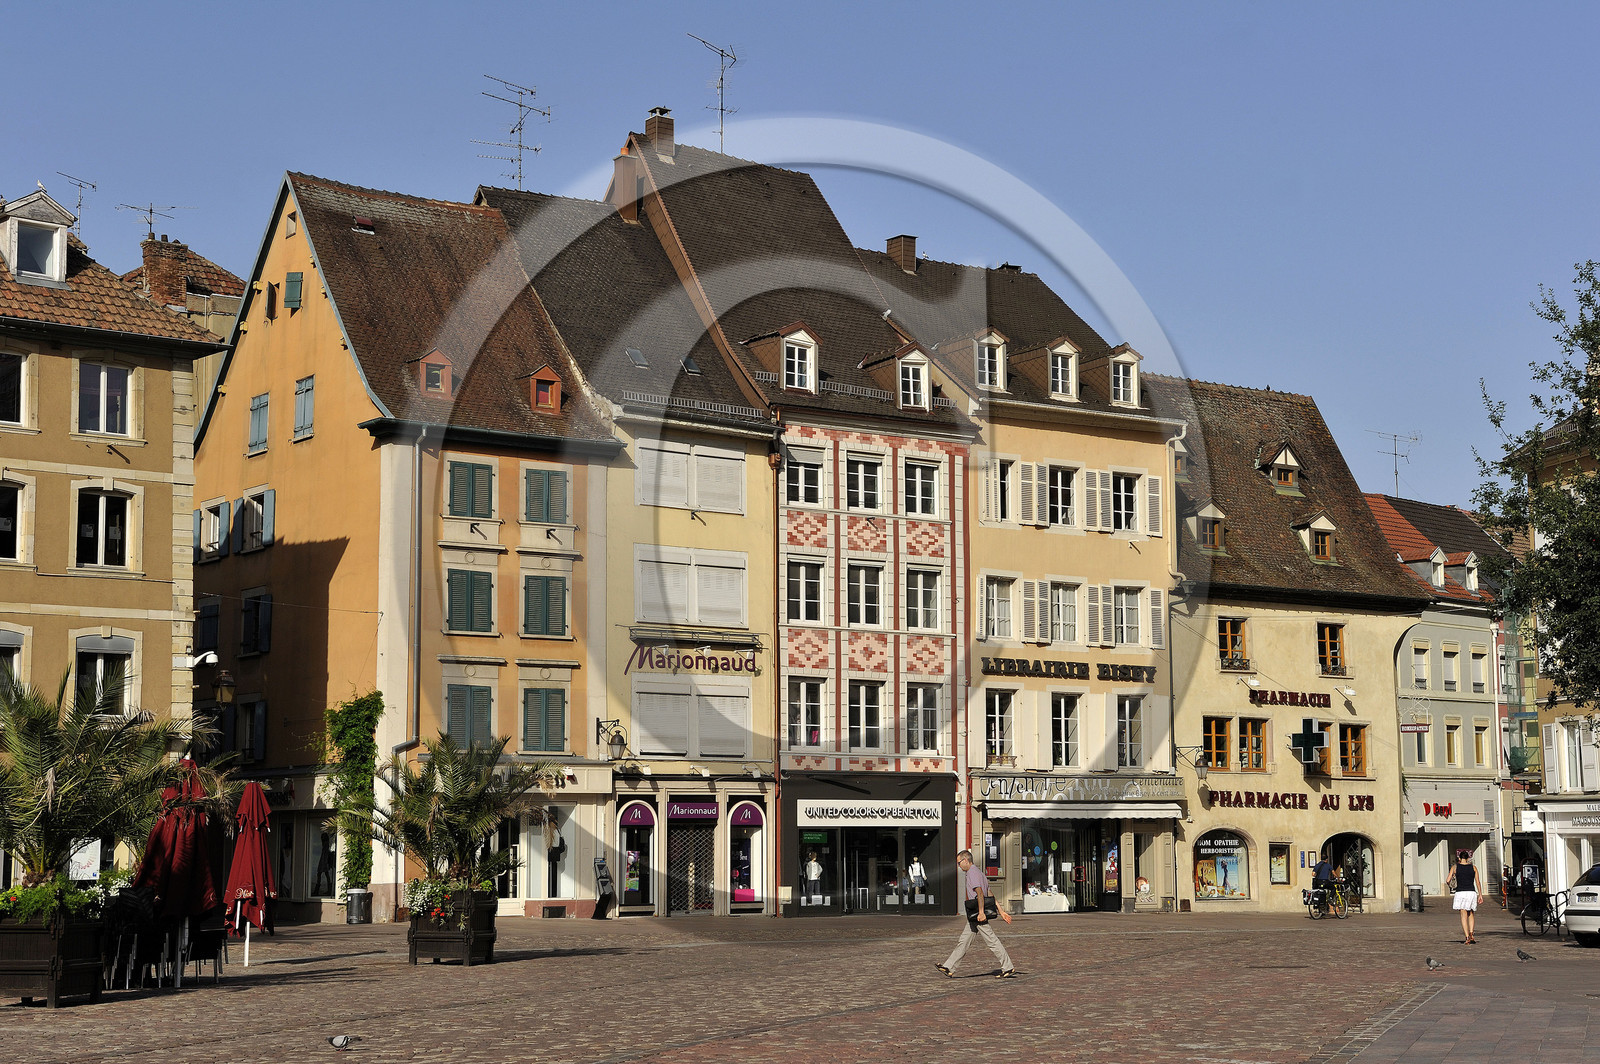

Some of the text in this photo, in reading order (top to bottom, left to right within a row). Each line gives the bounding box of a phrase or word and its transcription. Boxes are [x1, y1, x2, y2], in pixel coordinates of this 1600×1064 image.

[624, 645, 756, 675] Marionnaud
[981, 657, 1157, 683] LIBRAIRIE BISEY
[1249, 690, 1331, 708] PHARMACIE
[1209, 790, 1375, 811] PHARMACIE AU LYS
[669, 804, 717, 817] Marionnaud
[805, 807, 840, 818] UNITED
[841, 807, 877, 818] COLORS
[878, 808, 893, 818] OF
